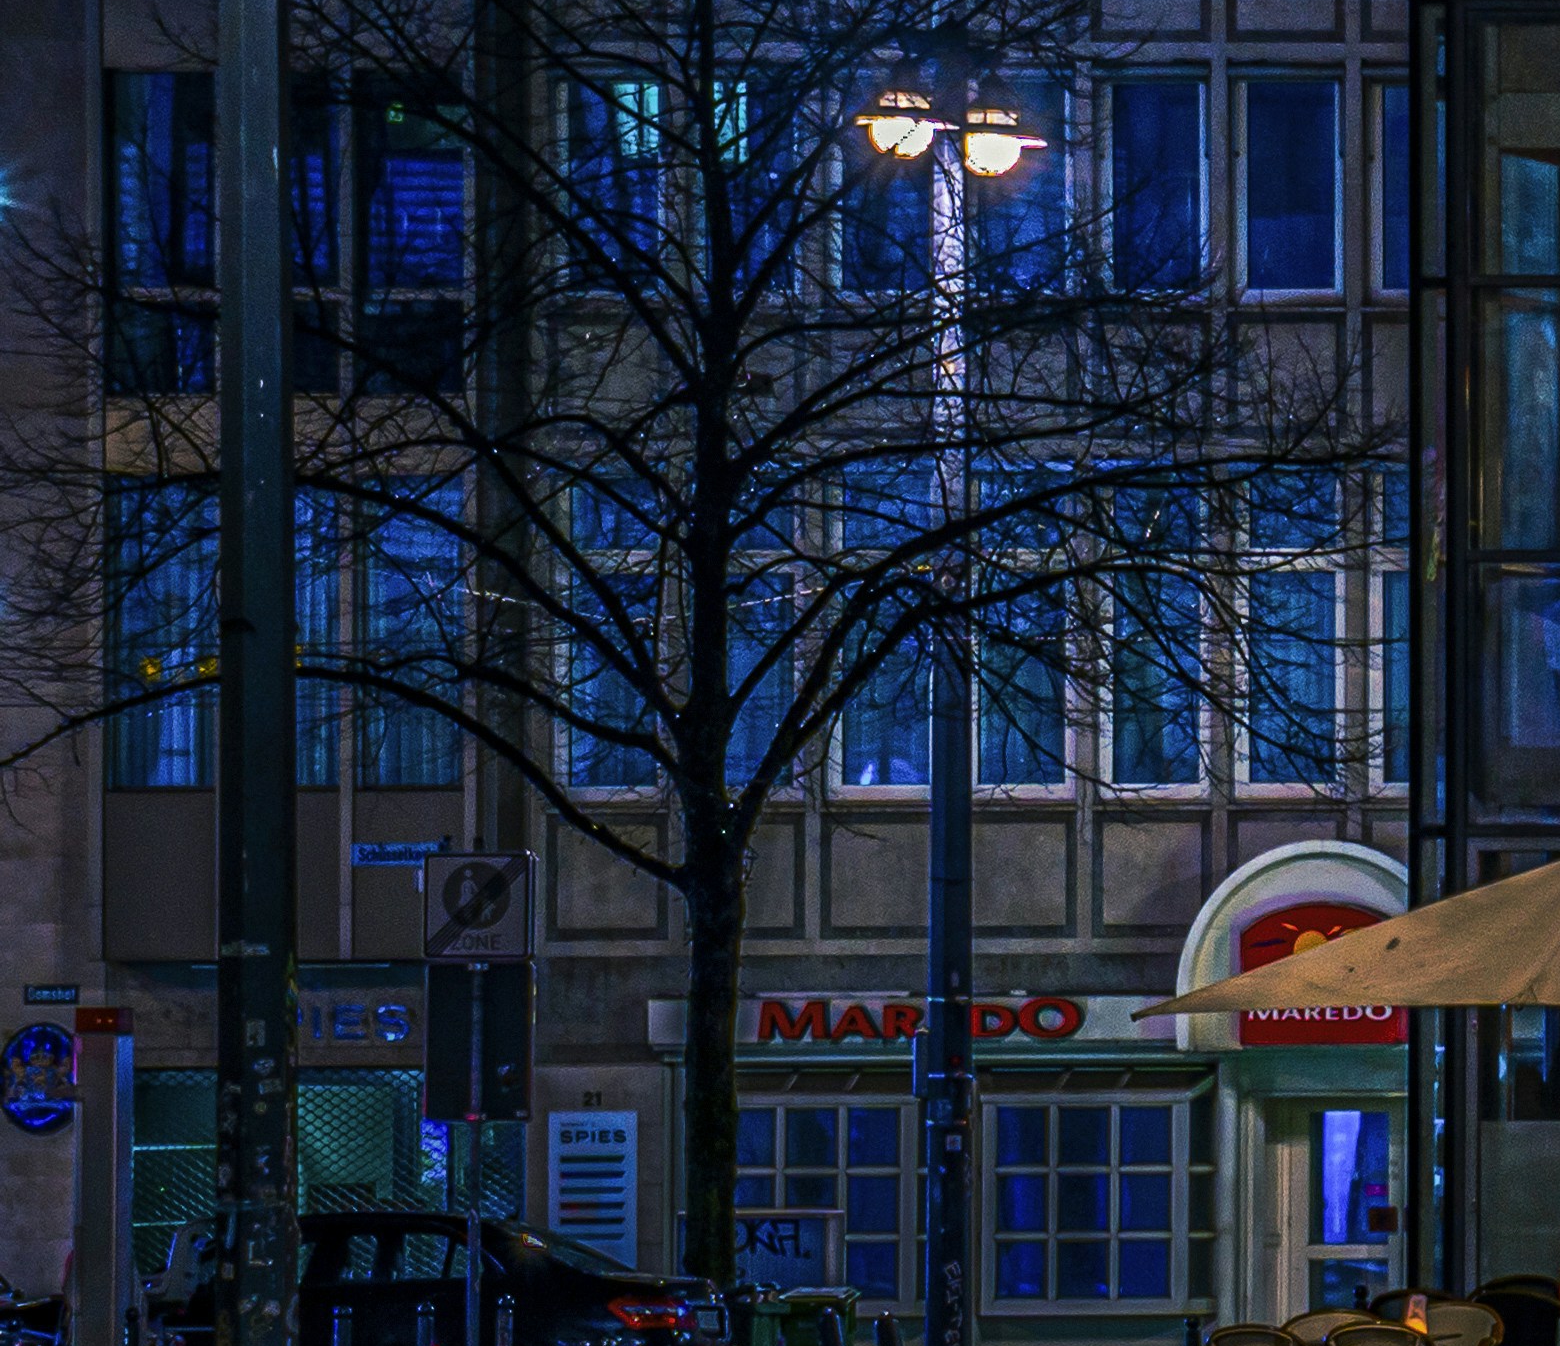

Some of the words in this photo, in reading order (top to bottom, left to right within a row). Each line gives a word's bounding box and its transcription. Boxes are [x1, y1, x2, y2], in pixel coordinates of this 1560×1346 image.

[450, 933, 501, 951] ZONE
[758, 997, 1084, 1040] MARDO
[1247, 1005, 1394, 1022] MAREDO
[297, 1004, 411, 1042] IES
[583, 1091, 602, 1106] 21
[560, 1129, 627, 1144] SPIES
